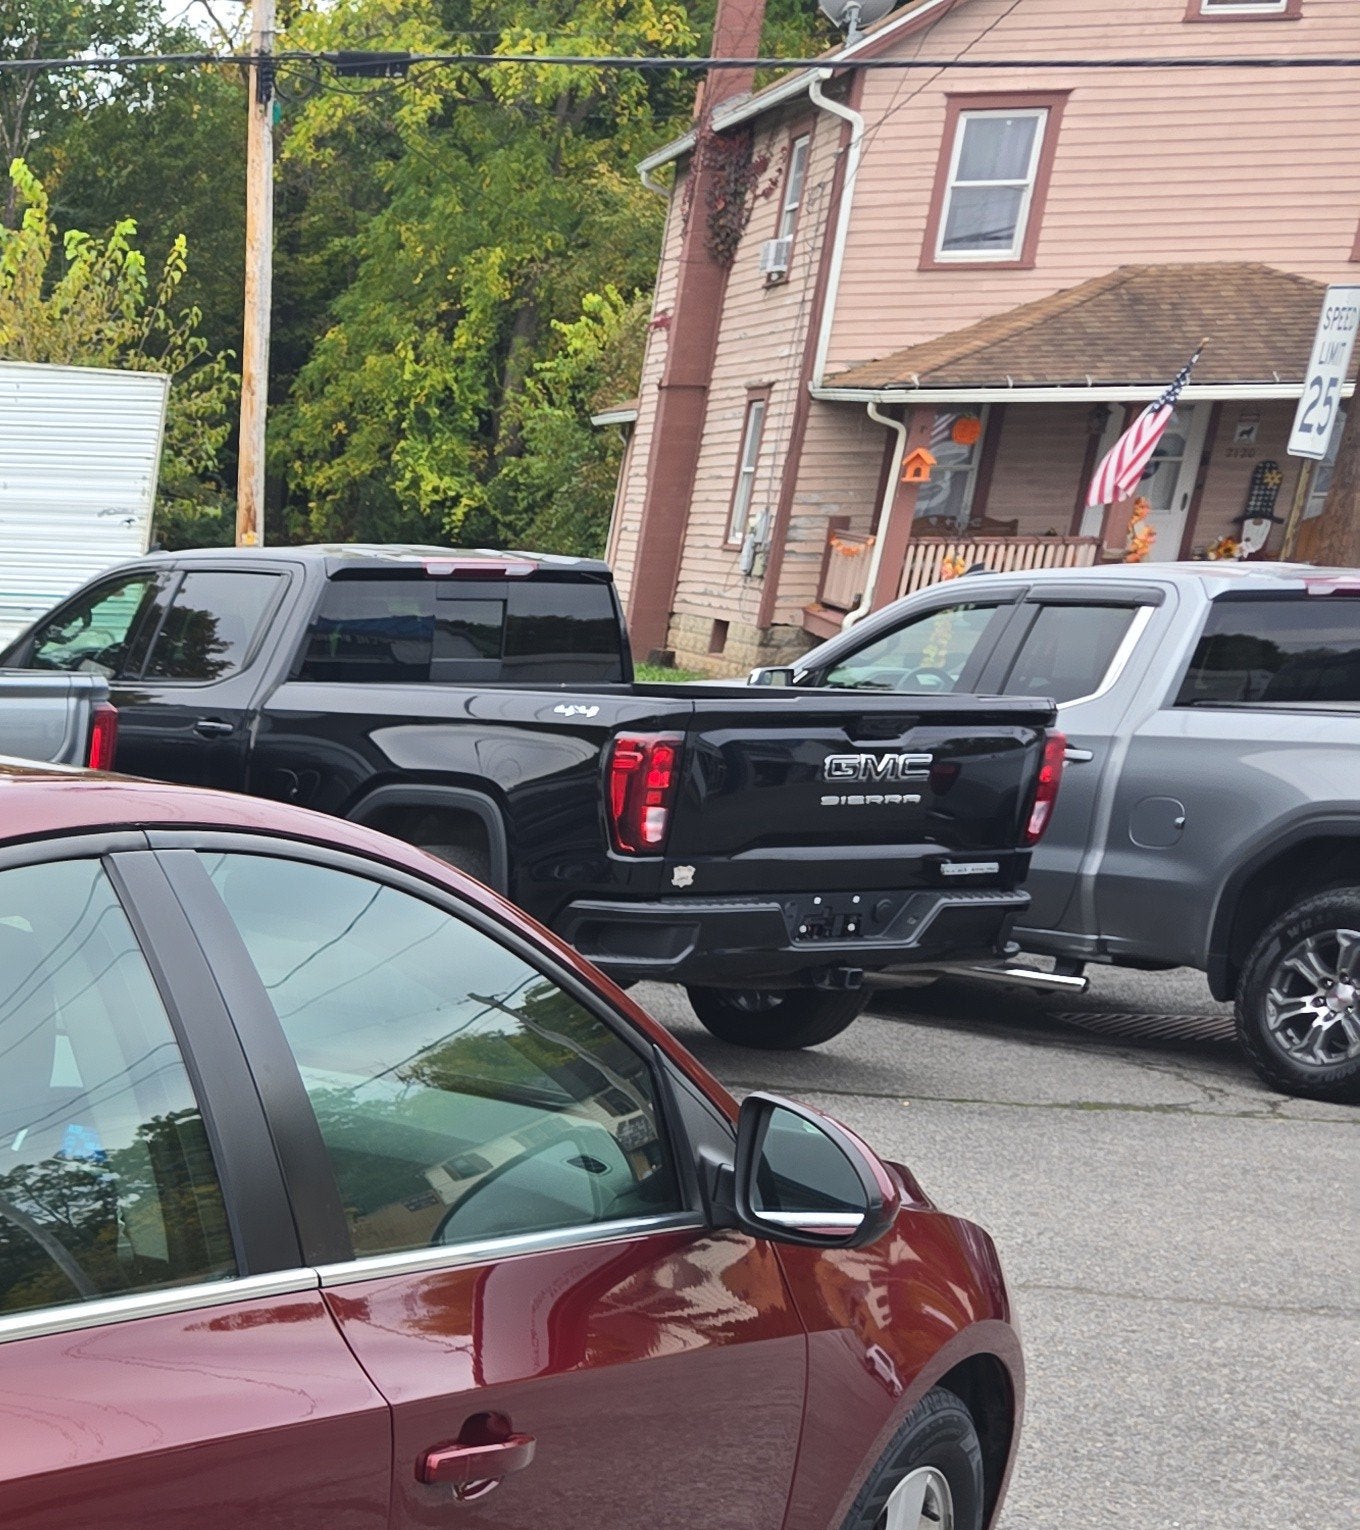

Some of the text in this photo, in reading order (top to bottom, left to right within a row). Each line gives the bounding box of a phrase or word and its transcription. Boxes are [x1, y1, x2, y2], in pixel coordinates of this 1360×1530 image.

[1323, 307, 1358, 331] SPEED
[1318, 341, 1347, 366] LIMIT
[1298, 375, 1340, 436] 25
[824, 753, 934, 782] GMC
[820, 794, 922, 806] SIERRA
